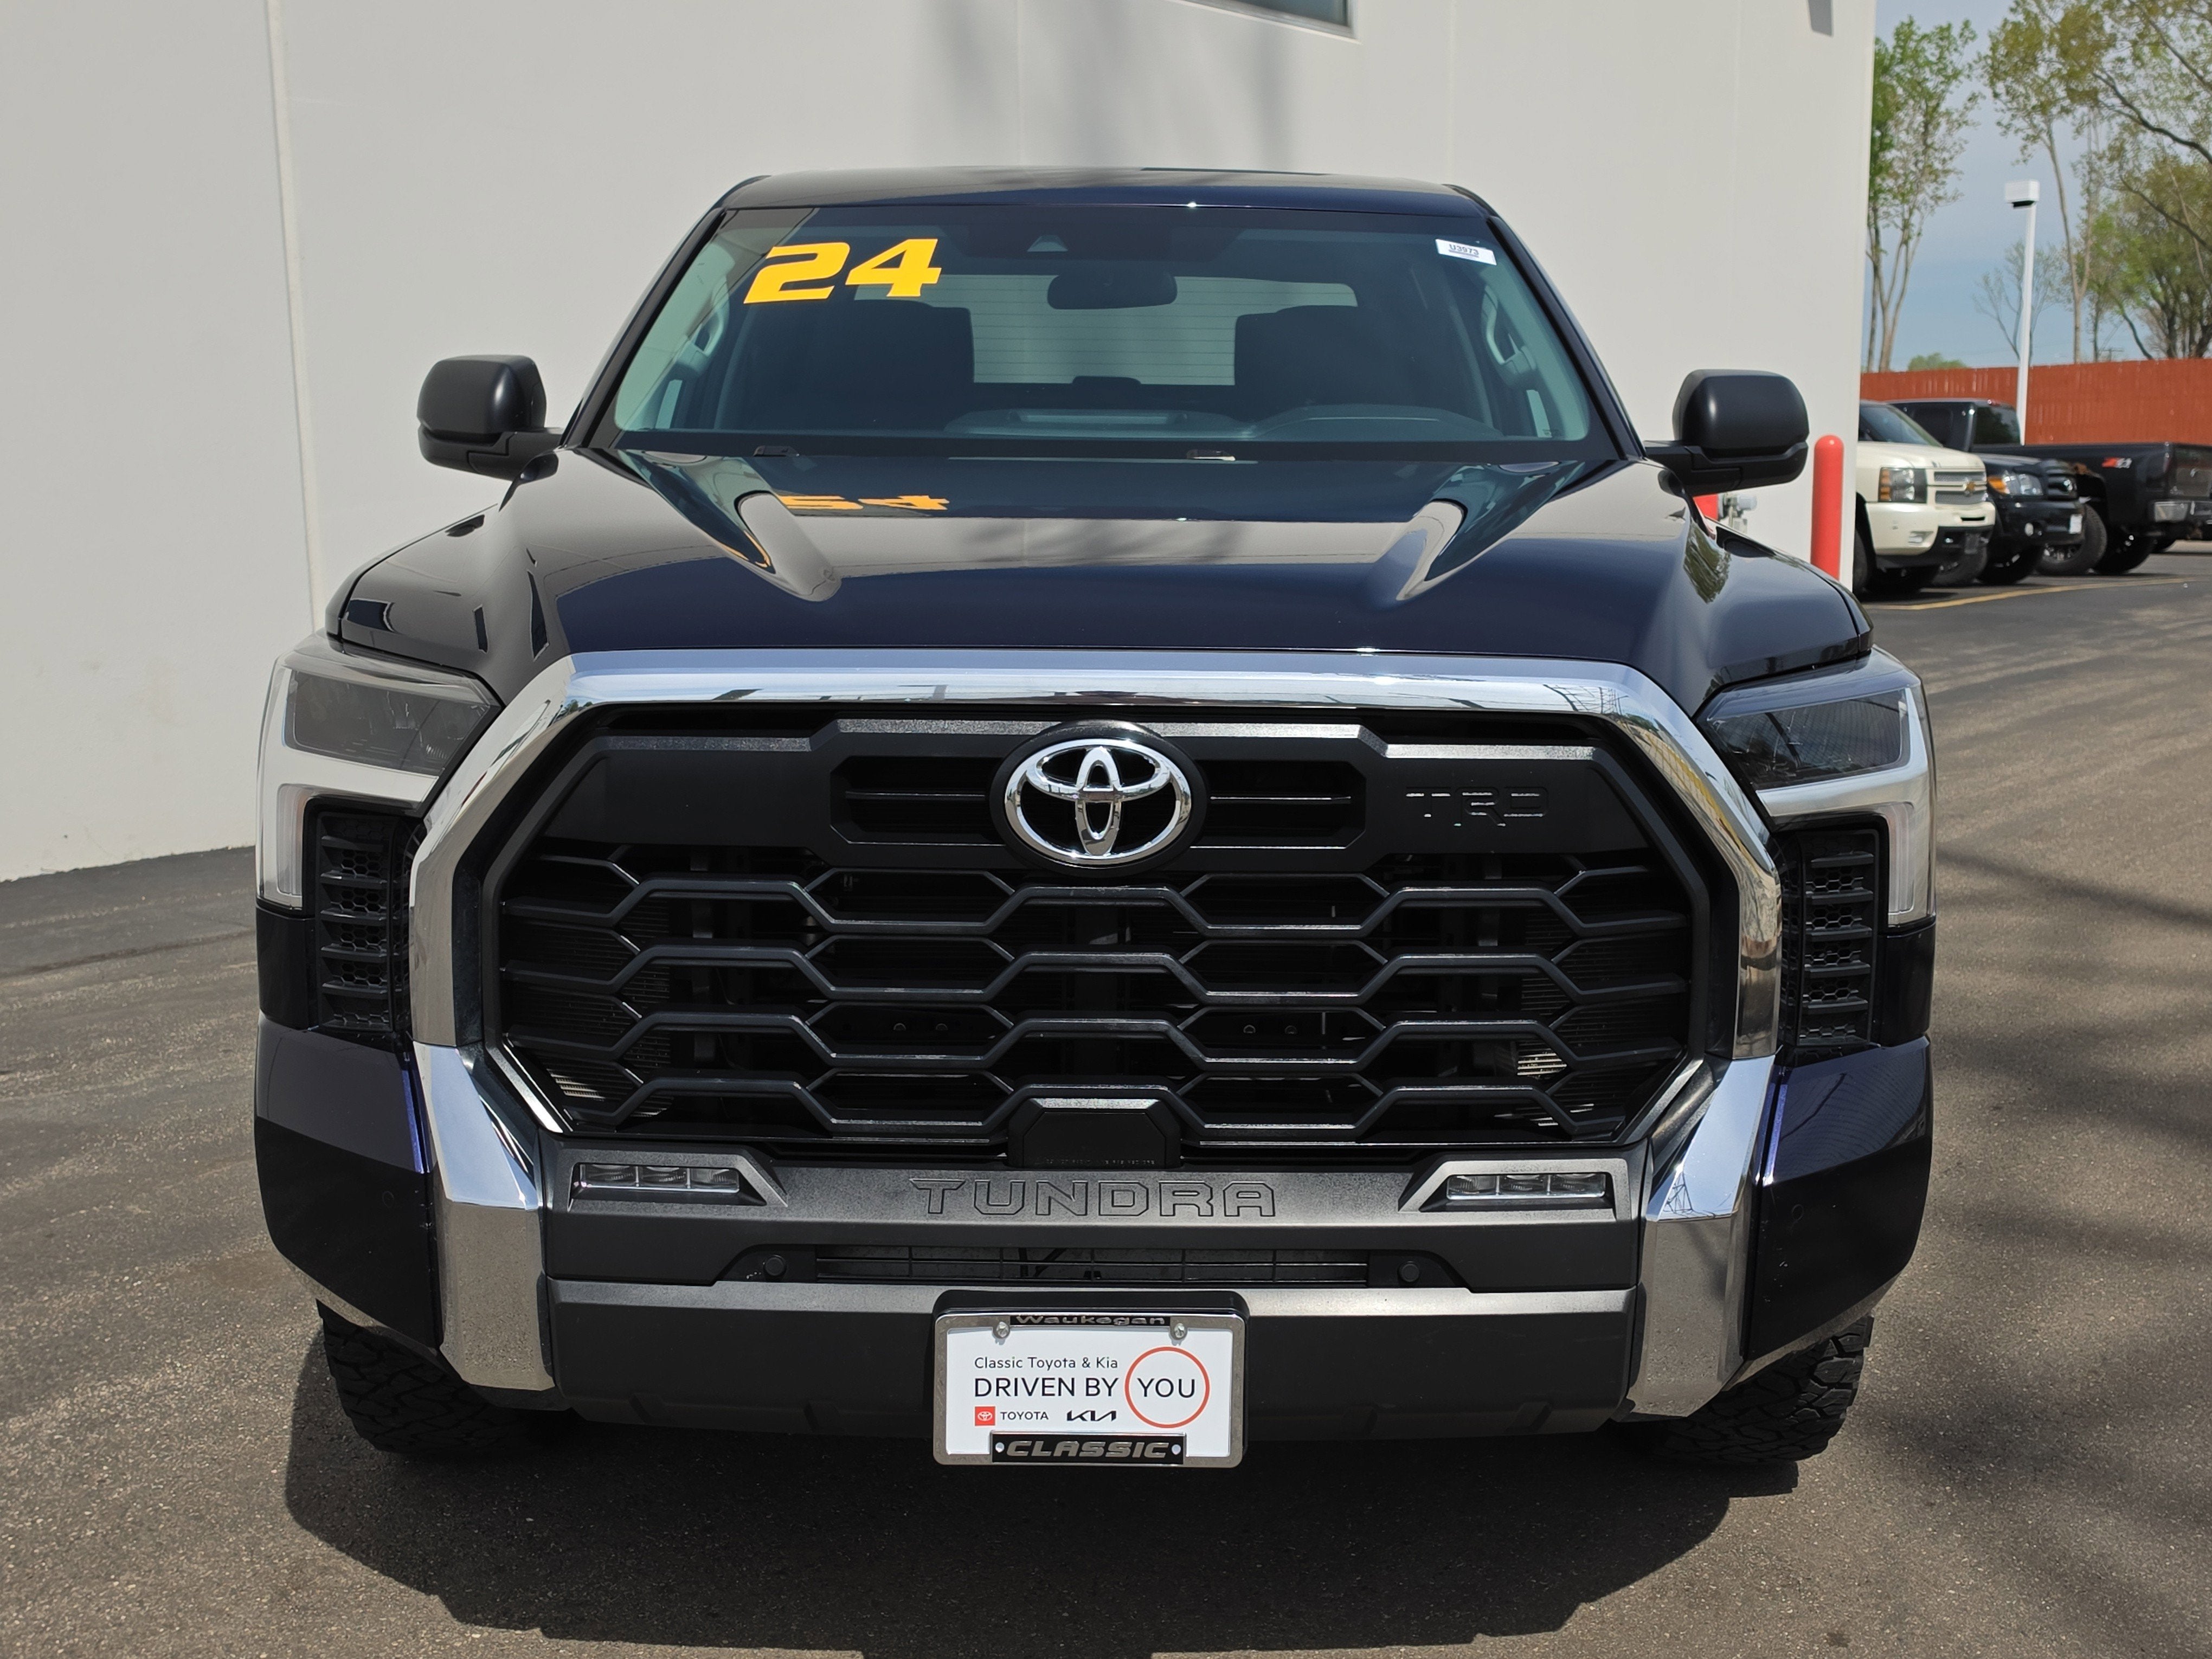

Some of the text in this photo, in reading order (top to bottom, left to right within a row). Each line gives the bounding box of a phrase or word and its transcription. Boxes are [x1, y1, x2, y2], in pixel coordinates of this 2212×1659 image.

[1449, 243, 1480, 255] U3973
[743, 239, 942, 304] 24
[1406, 787, 1548, 827] TRD
[909, 1179, 1276, 1217] TUNDRA
[1016, 1315, 1165, 1326] Waukegan
[974, 1356, 1118, 1371] Classic Toyota & Kia
[975, 1377, 1196, 1398] DRIVEN BY YOU
[1000, 1411, 1049, 1421] TOYOTA
[1006, 1441, 1169, 1458] CLASSIC
